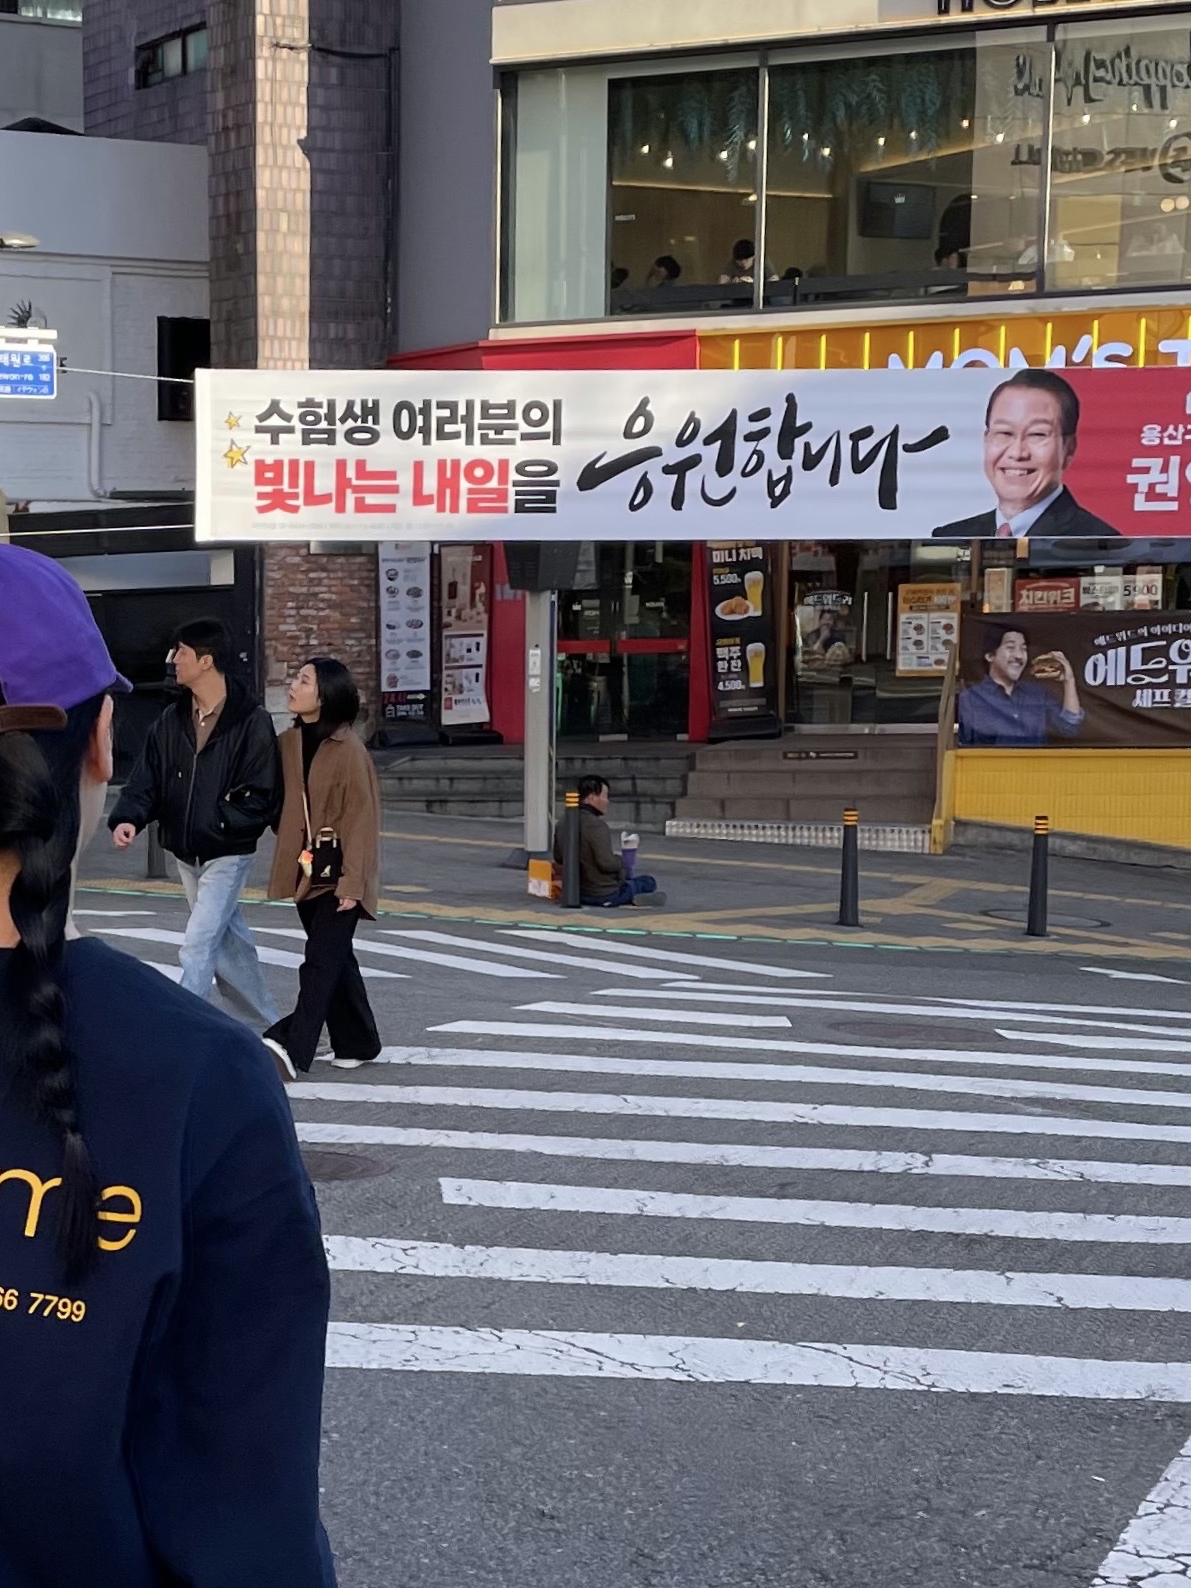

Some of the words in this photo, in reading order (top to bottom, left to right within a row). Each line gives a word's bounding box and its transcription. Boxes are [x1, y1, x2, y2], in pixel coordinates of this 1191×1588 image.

[254, 397, 380, 446] 수험생
[392, 399, 562, 446] 여러분의
[576, 392, 950, 512] 응원합니다
[254, 458, 400, 514] 빛나는
[412, 458, 560, 514] 내일을
[1126, 455, 1191, 511] 권
[712, 551, 737, 563] 미니
[1019, 588, 1075, 606] 치킨위크
[28, 1292, 86, 1323] 7799
